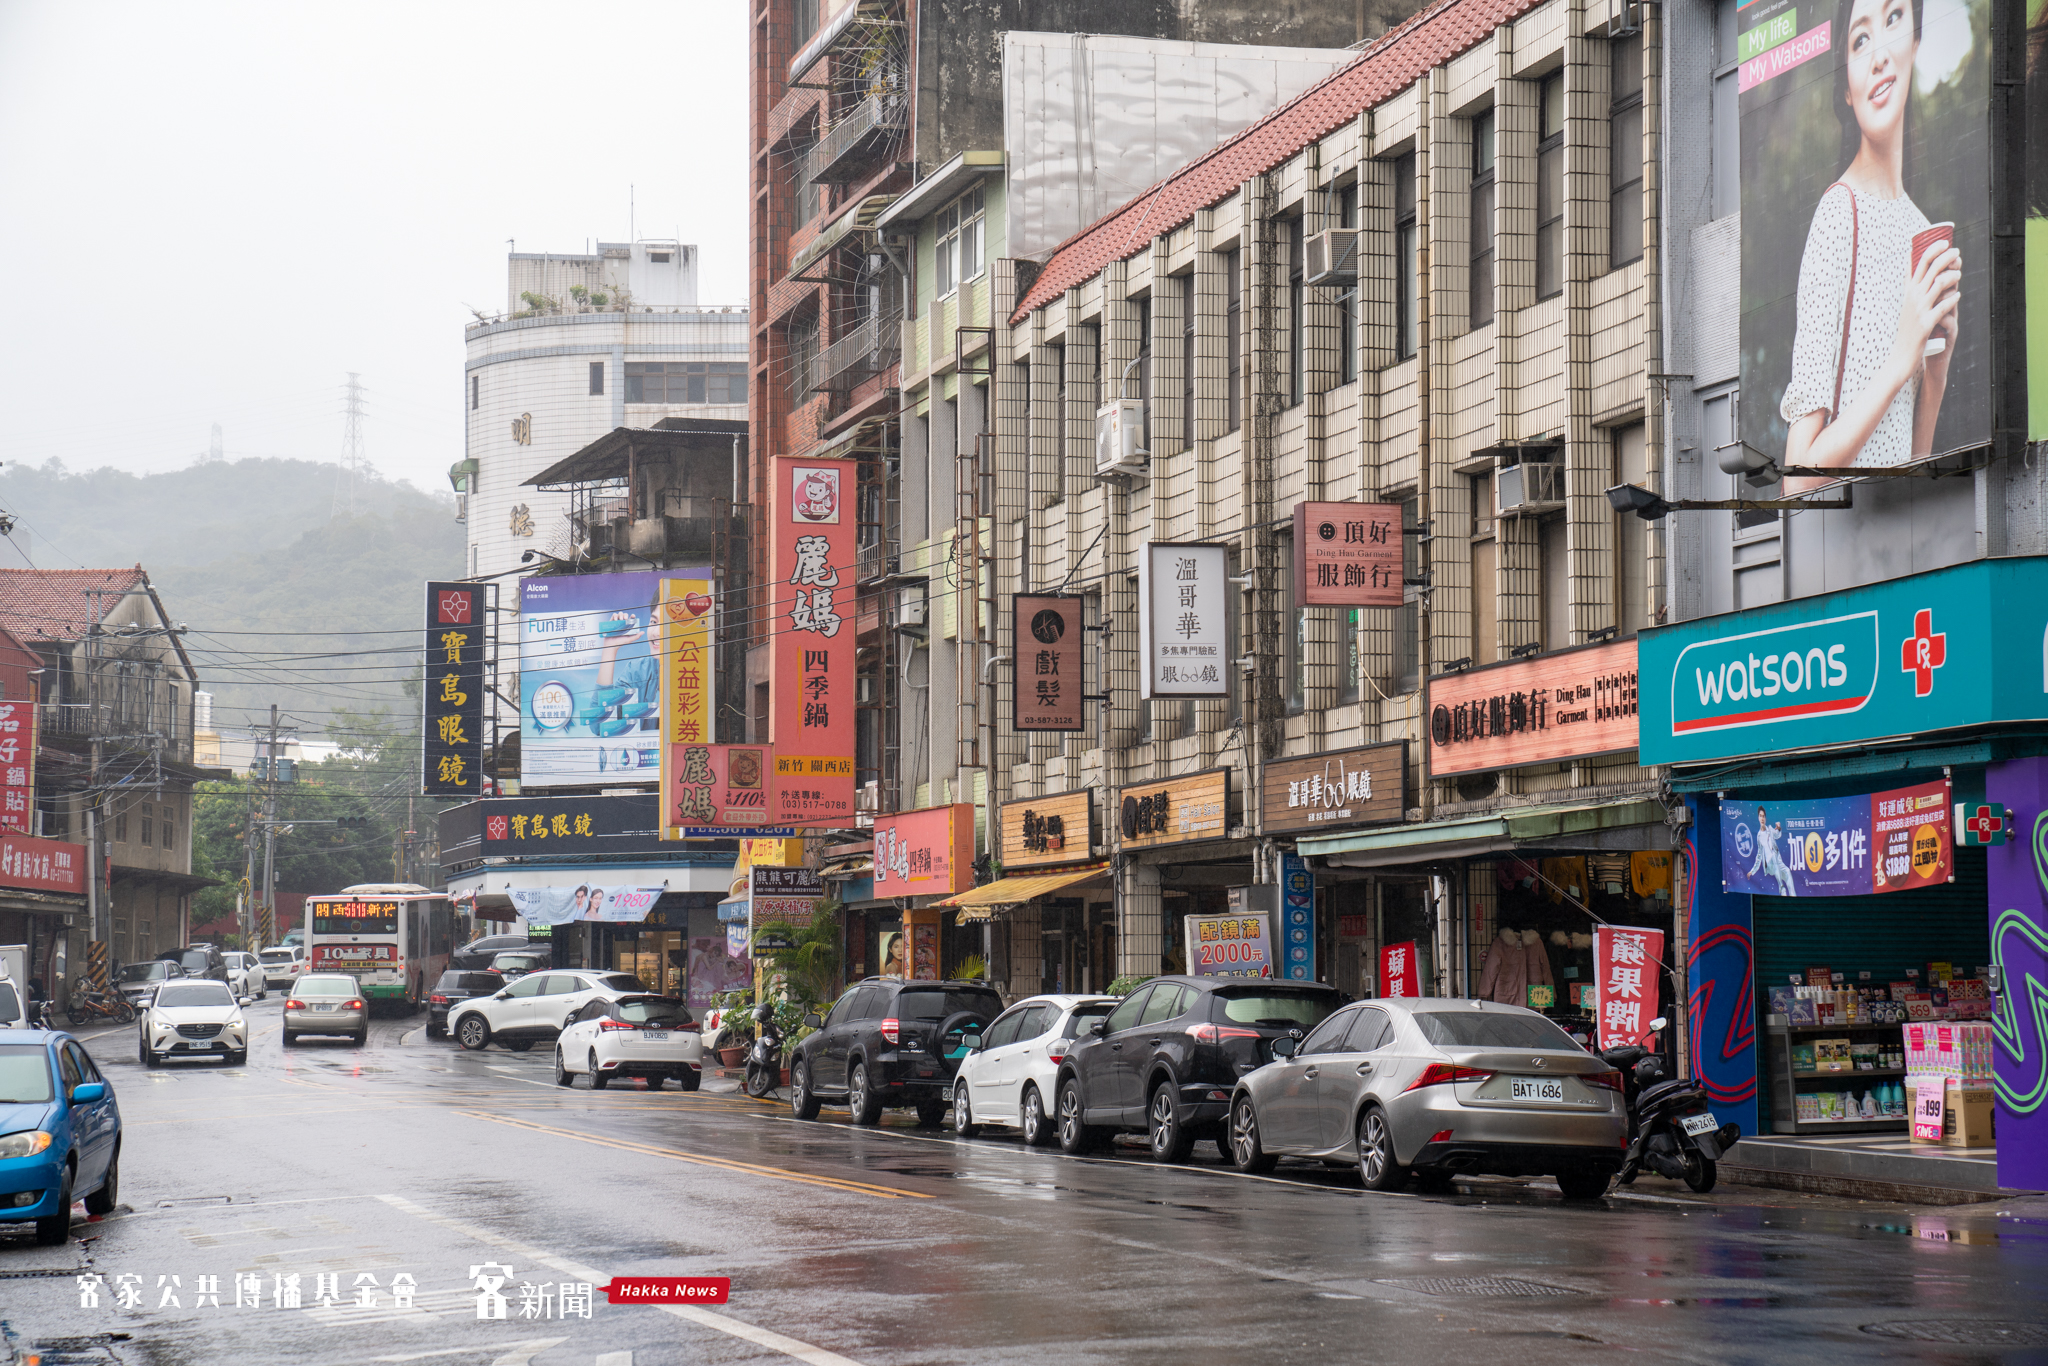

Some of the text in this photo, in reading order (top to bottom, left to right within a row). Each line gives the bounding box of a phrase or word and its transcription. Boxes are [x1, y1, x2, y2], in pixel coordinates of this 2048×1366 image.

[1749, 17, 1793, 52] My life.
[1749, 31, 1830, 82] My Watsons.
[1343, 520, 1391, 545] 頂好
[1316, 549, 1392, 559] Ding Hau Garment
[789, 535, 843, 638] 麗媽
[1317, 563, 1392, 588] 服飾行
[527, 584, 548, 592] Alcon
[1175, 557, 1201, 640] 溫哥華
[1161, 664, 1219, 684] 眼鏡
[1696, 643, 1847, 706] watsons
[678, 641, 700, 742] 公益彩券
[804, 650, 829, 728] 四季鍋
[1556, 685, 1591, 704] Ding Hau
[437, 631, 469, 786] 寶島眼鏡
[1452, 689, 1552, 743] 頂好服飾行
[1556, 708, 1588, 725] Garment
[778, 759, 851, 773] 新竹 關西店
[679, 747, 717, 823] 麗媽
[781, 790, 824, 800] 外送專線:
[1288, 770, 1373, 807] 溫哥華 眼鏡
[733, 792, 759, 806] 110
[782, 800, 847, 809] (03)517-0788
[1879, 796, 1914, 818] 好運成兔
[511, 813, 593, 840] 寶島眼鏡
[887, 826, 908, 883] 麗媽
[1787, 832, 1805, 871] 加
[1809, 840, 1819, 864] $1
[1825, 828, 1867, 871] 多1件
[1886, 854, 1910, 877] $1888
[614, 893, 651, 908] 1,980
[1199, 919, 1260, 942] 配鏡滿
[1201, 942, 1263, 965] 2000元
[1910, 1004, 1930, 1017] $69
[1513, 1083, 1561, 1098] BAT-1686
[1685, 1117, 1716, 1132] MNH-2615
[1916, 1125, 1933, 1138] SAVE
